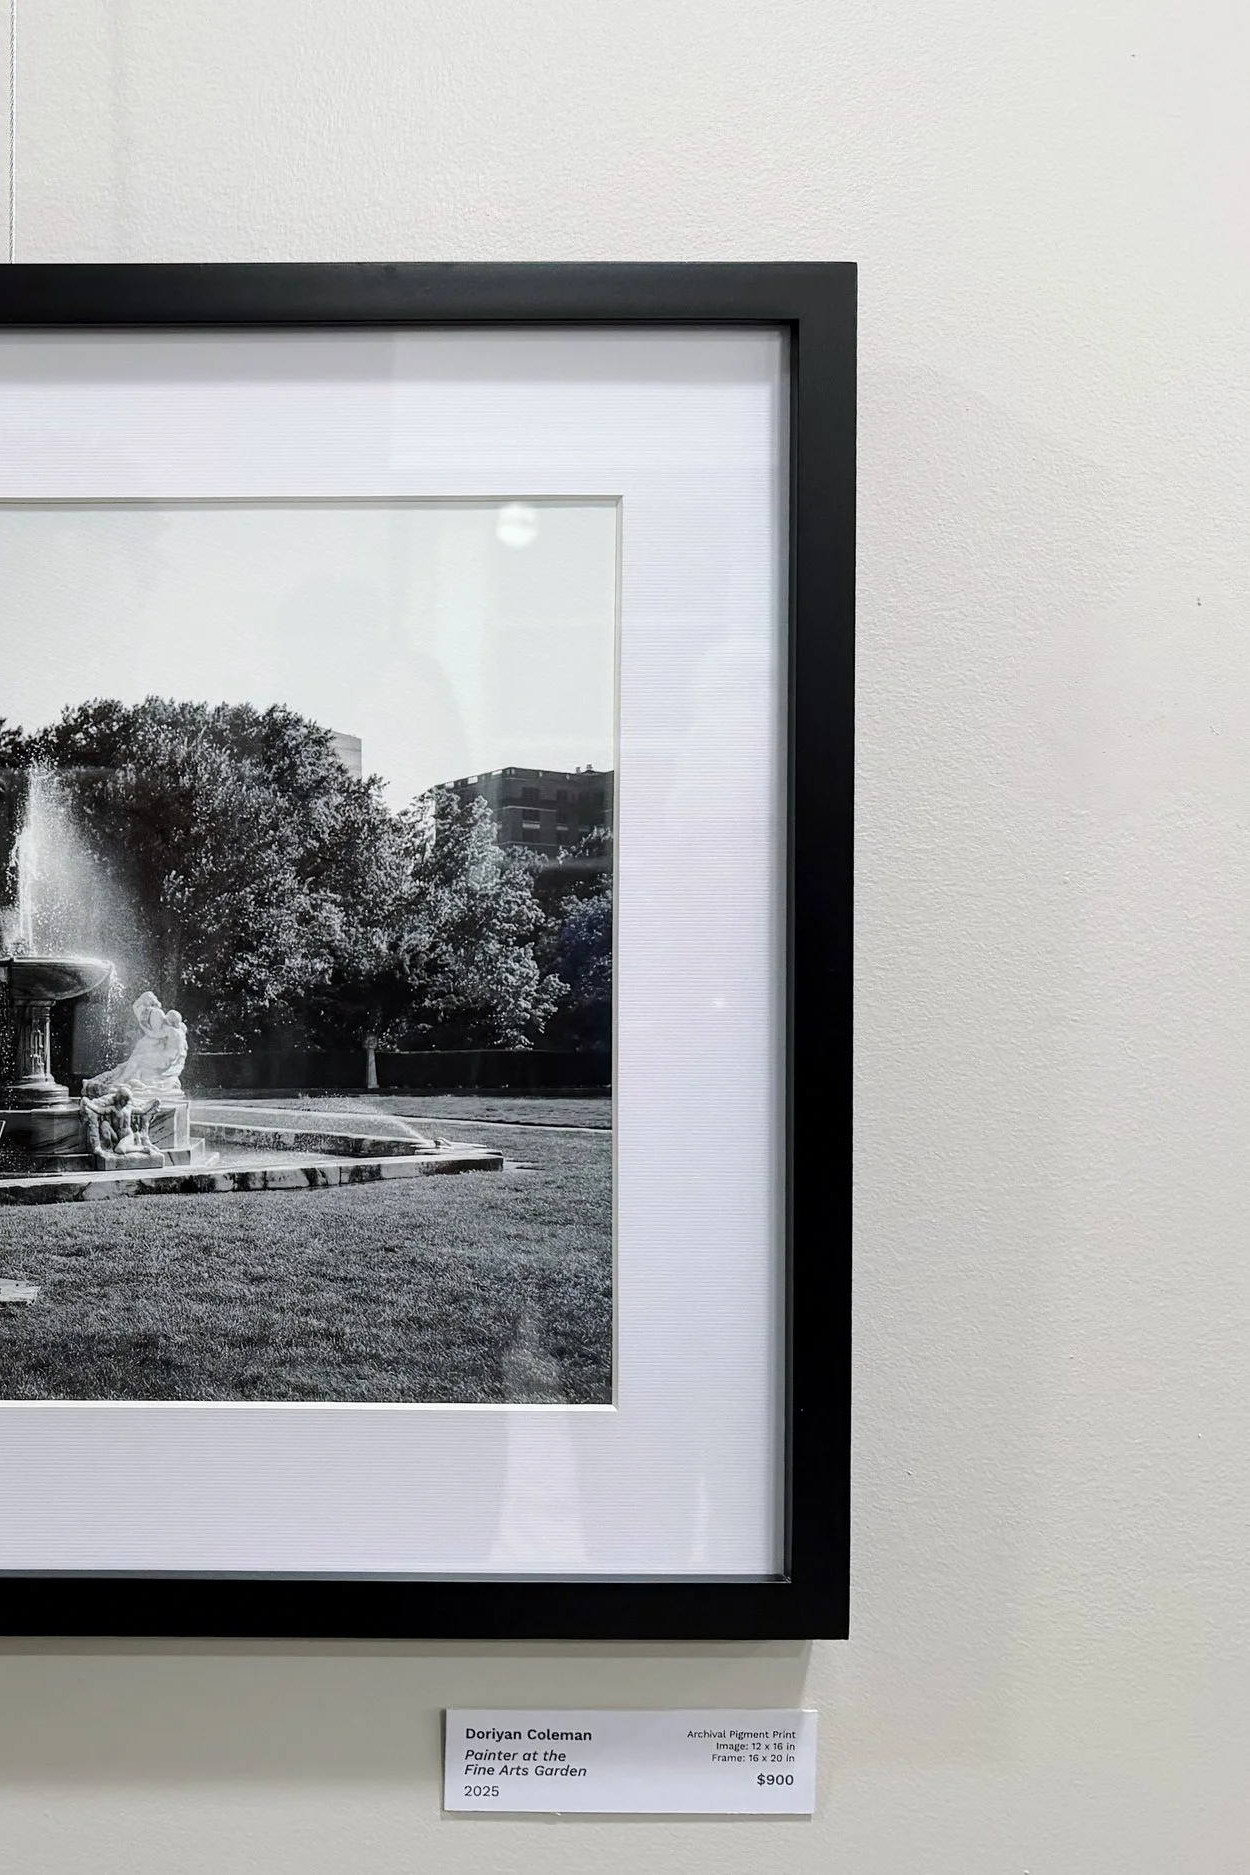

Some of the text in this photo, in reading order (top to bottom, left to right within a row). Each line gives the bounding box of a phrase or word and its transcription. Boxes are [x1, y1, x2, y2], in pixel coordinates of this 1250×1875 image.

[465, 1728, 592, 1742] Doriyan Coleman
[687, 1730, 796, 1740] Archival Pigment Print
[716, 1742, 749, 1752] Image:
[752, 1742, 762, 1751] 12
[773, 1742, 783, 1751] 16
[786, 1742, 796, 1751] in
[465, 1749, 567, 1762] Painter at the
[711, 1754, 746, 1763] Frame:
[749, 1754, 759, 1763] 16
[770, 1754, 783, 1763] 20
[786, 1754, 795, 1763] in
[464, 1764, 587, 1777] Fine Arts Garden
[757, 1773, 794, 1786] $900
[464, 1785, 500, 1797] 2025
